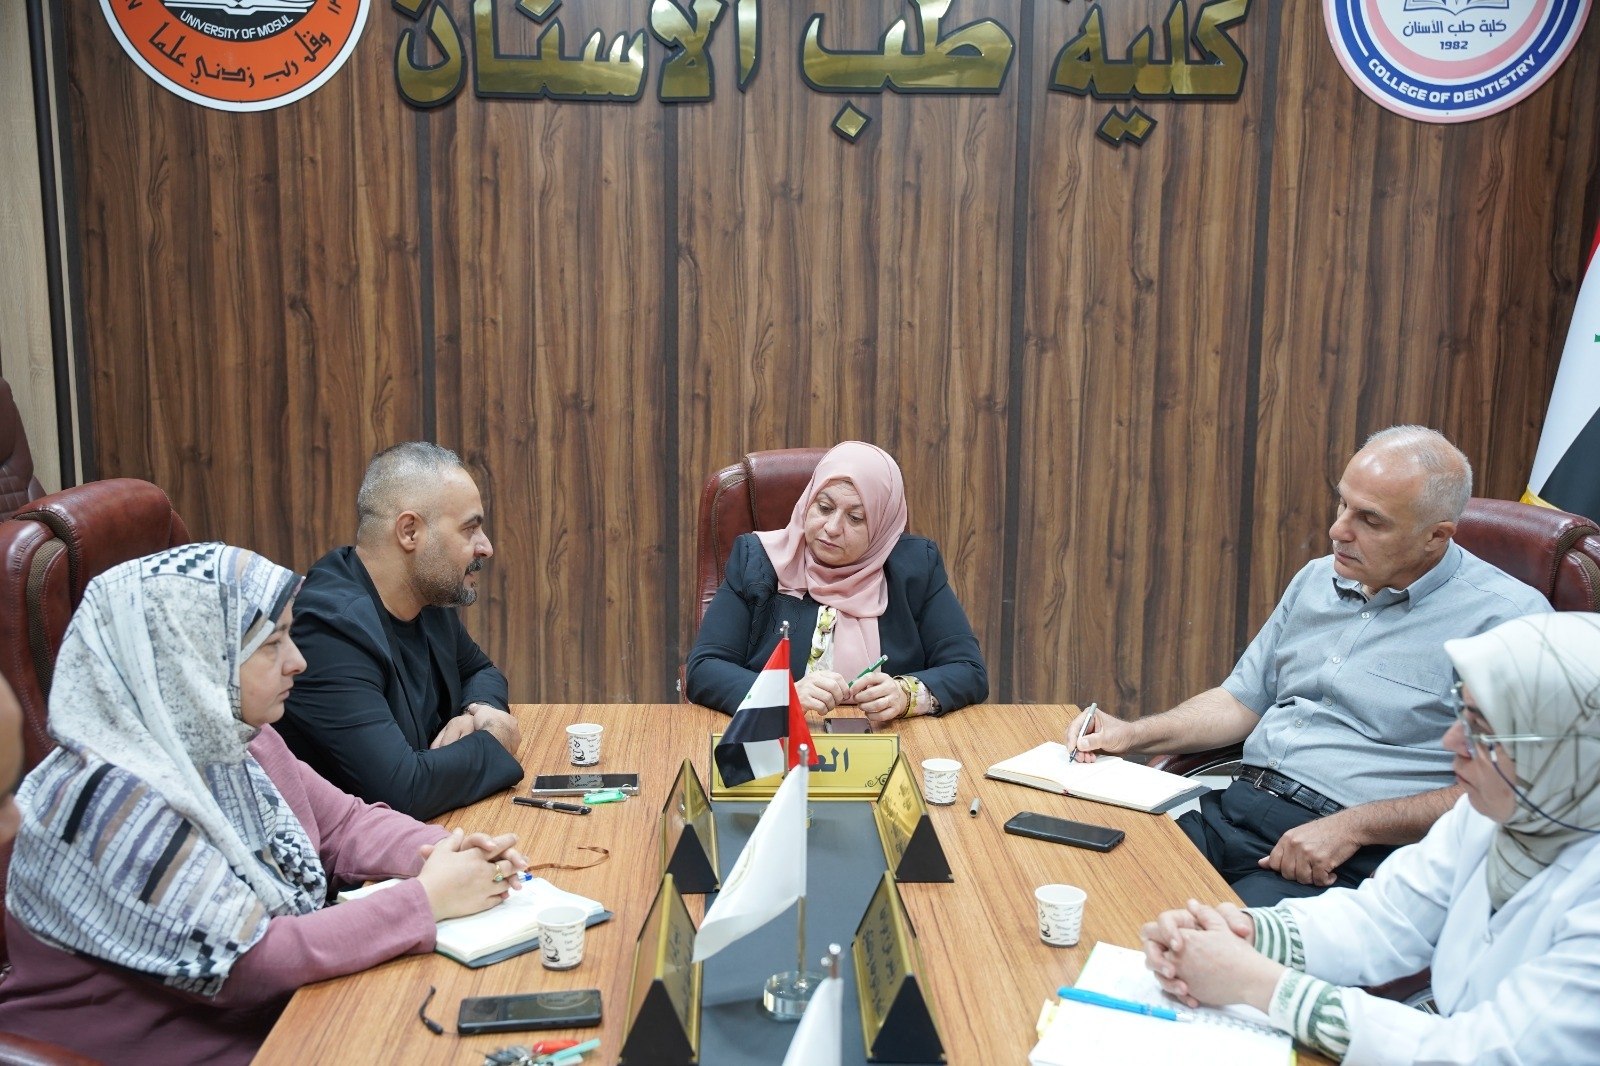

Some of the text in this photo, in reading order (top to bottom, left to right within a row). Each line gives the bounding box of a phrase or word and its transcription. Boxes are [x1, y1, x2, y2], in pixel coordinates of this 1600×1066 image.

[180, 10, 294, 39] UNIVERSITY OF MOSUL
[1447, 20, 1475, 37] طب
[1479, 19, 1507, 38] كلية
[1439, 40, 1469, 50] 1982
[190, 55, 255, 88] زدني
[799, 0, 1016, 144] طب
[1048, 0, 1251, 147] كلية
[1368, 53, 1536, 103] COLLEGE OF DENTISTRY
